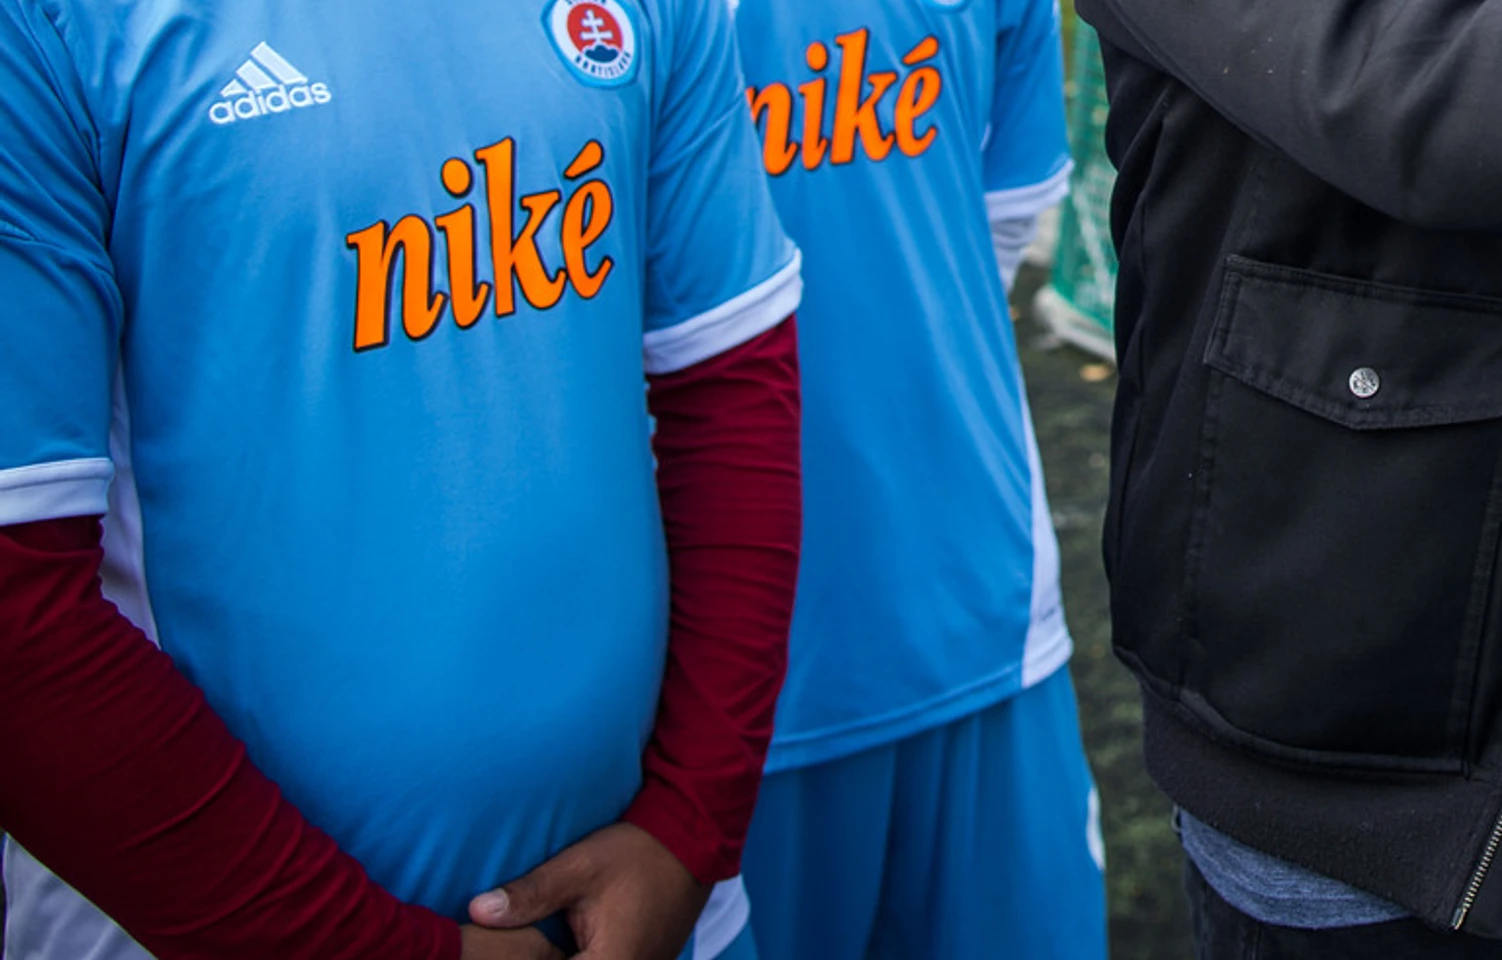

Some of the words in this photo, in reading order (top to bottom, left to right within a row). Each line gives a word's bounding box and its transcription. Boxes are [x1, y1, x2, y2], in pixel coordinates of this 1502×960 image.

[208, 80, 332, 125] adidas
[745, 27, 942, 176] niké
[346, 136, 614, 353] niké
